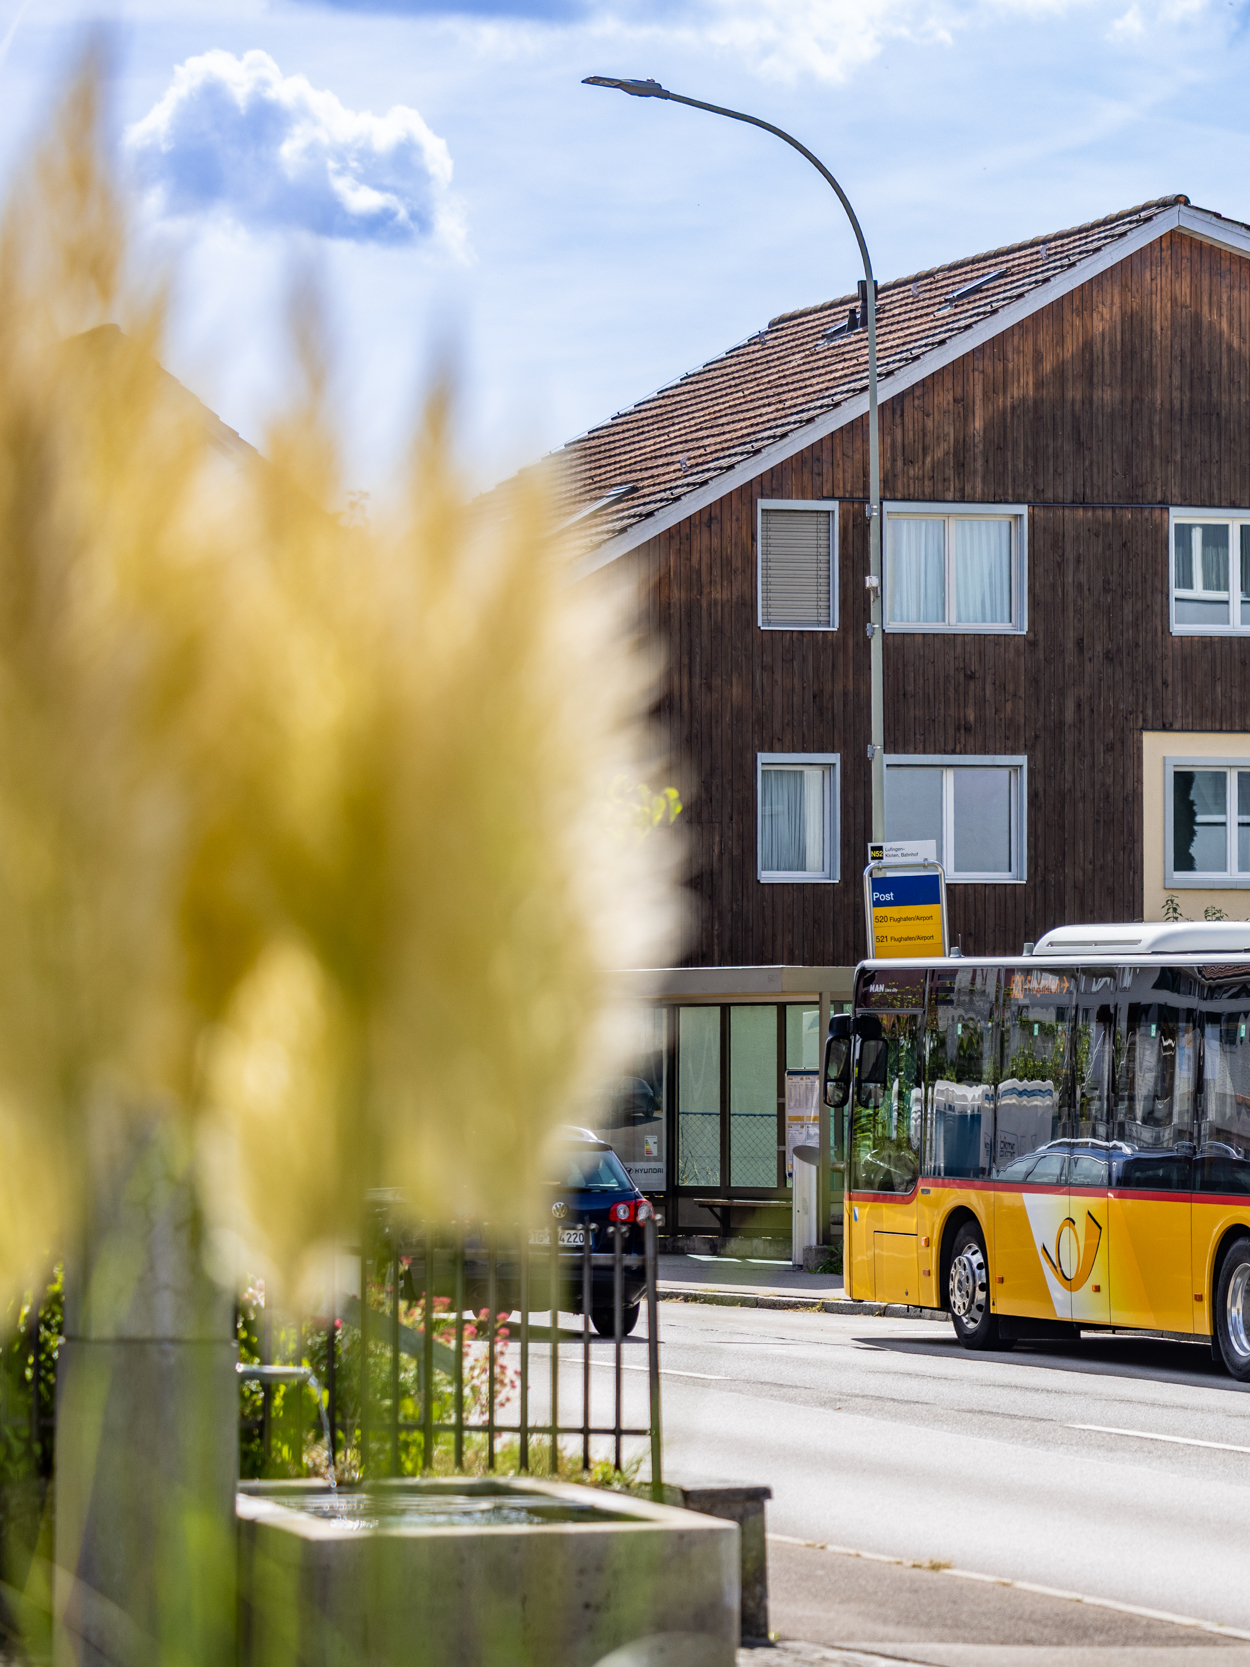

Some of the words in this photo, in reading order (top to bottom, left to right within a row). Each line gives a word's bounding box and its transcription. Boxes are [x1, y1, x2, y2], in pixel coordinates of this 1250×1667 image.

[870, 850, 884, 858] N52
[873, 892, 894, 901] Post
[874, 915, 889, 924] 520
[889, 915, 934, 924] Flughafen/Airport
[875, 935, 889, 944] 521
[890, 935, 935, 944] Flughafen/Airport
[869, 983, 885, 993] MAN
